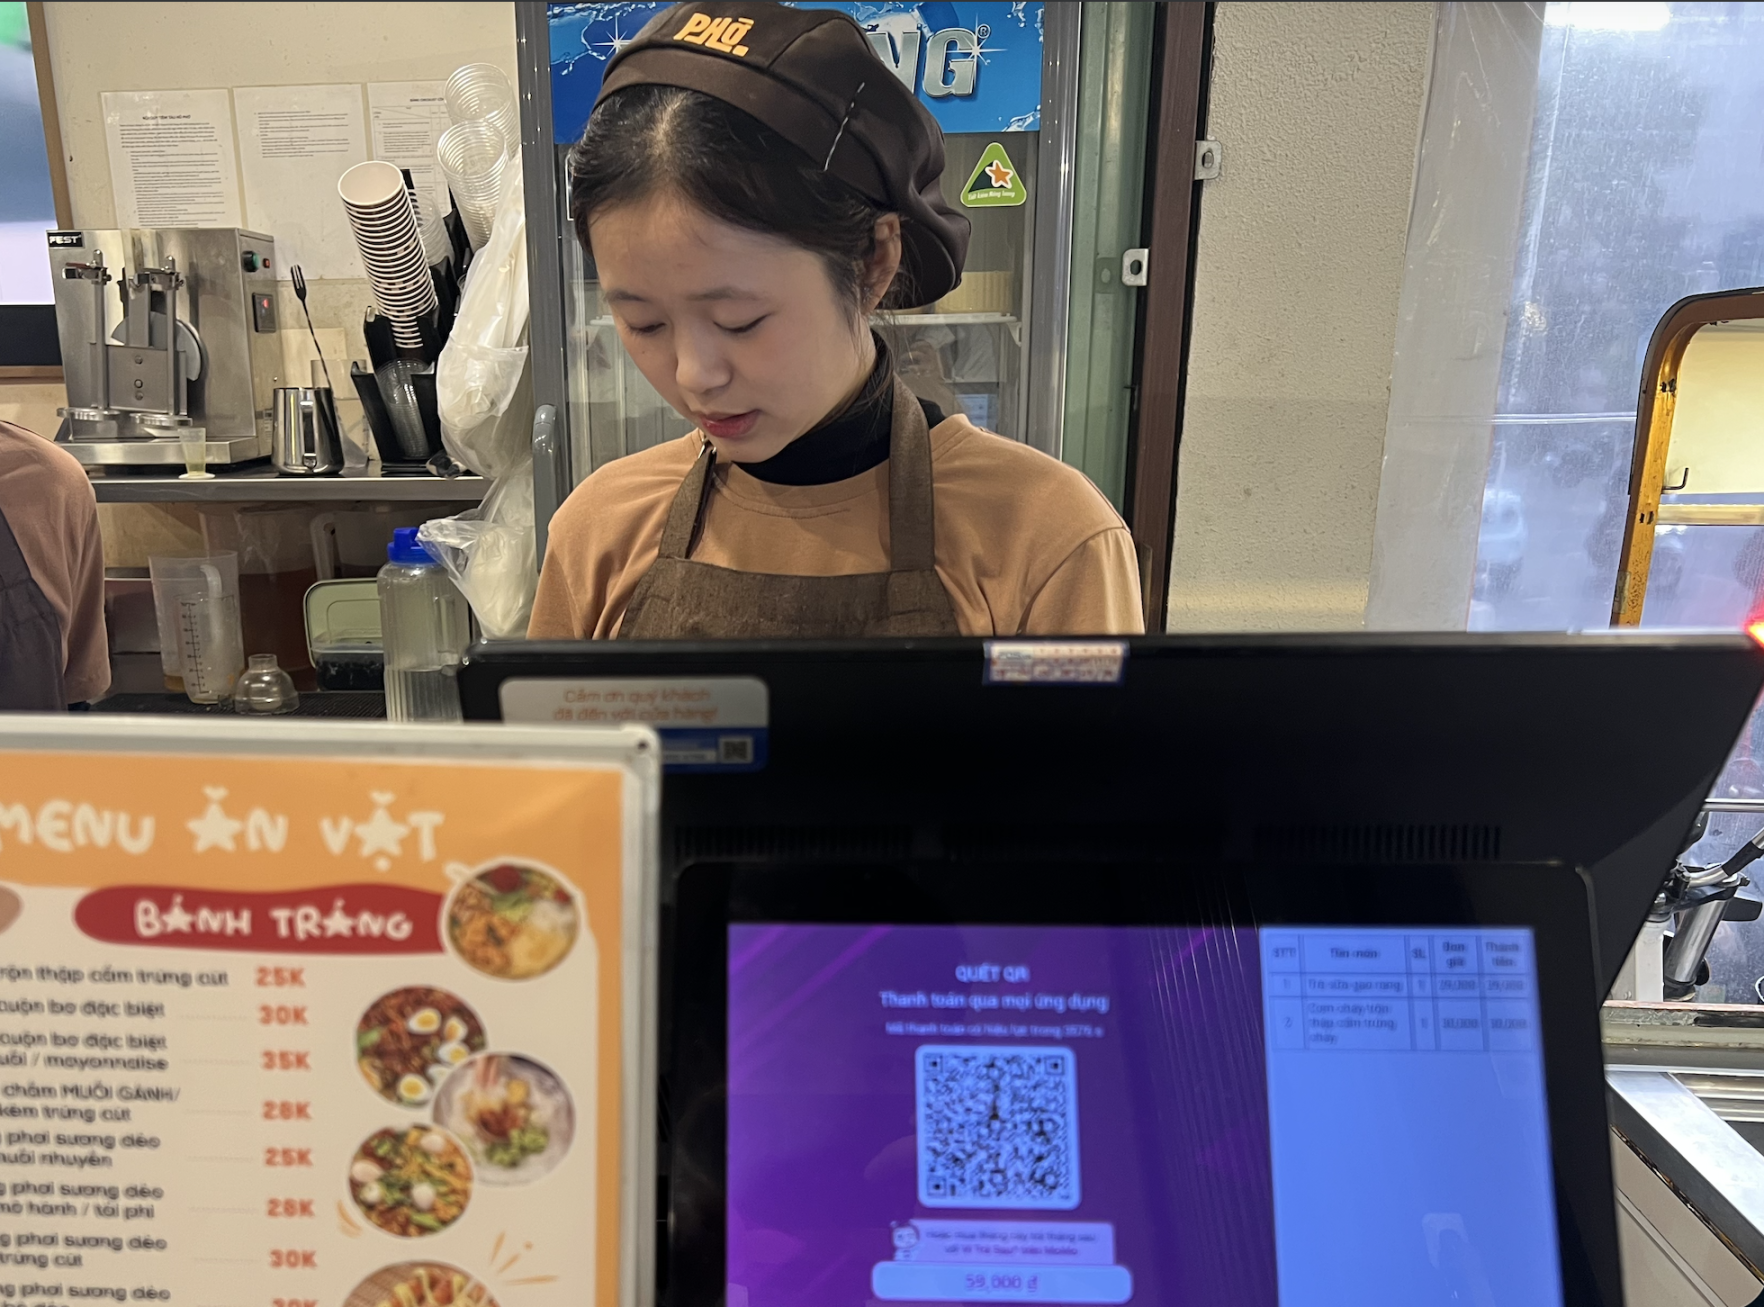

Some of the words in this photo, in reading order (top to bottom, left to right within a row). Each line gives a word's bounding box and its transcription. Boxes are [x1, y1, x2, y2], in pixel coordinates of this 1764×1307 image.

[49, 235, 78, 244] FEST
[0, 799, 156, 854] MENU
[133, 892, 252, 938] BÁNH
[269, 898, 414, 941] TRÁNG
[256, 966, 306, 987] 25K
[1002, 963, 1031, 983] QR
[879, 990, 929, 1008] Thanh
[968, 994, 999, 1012] qua
[259, 1005, 310, 1026] 30K
[44, 1054, 170, 1073] mayonnaise
[262, 1050, 312, 1071] 35K
[265, 1147, 314, 1168] 25K
[269, 1249, 319, 1270] 30K
